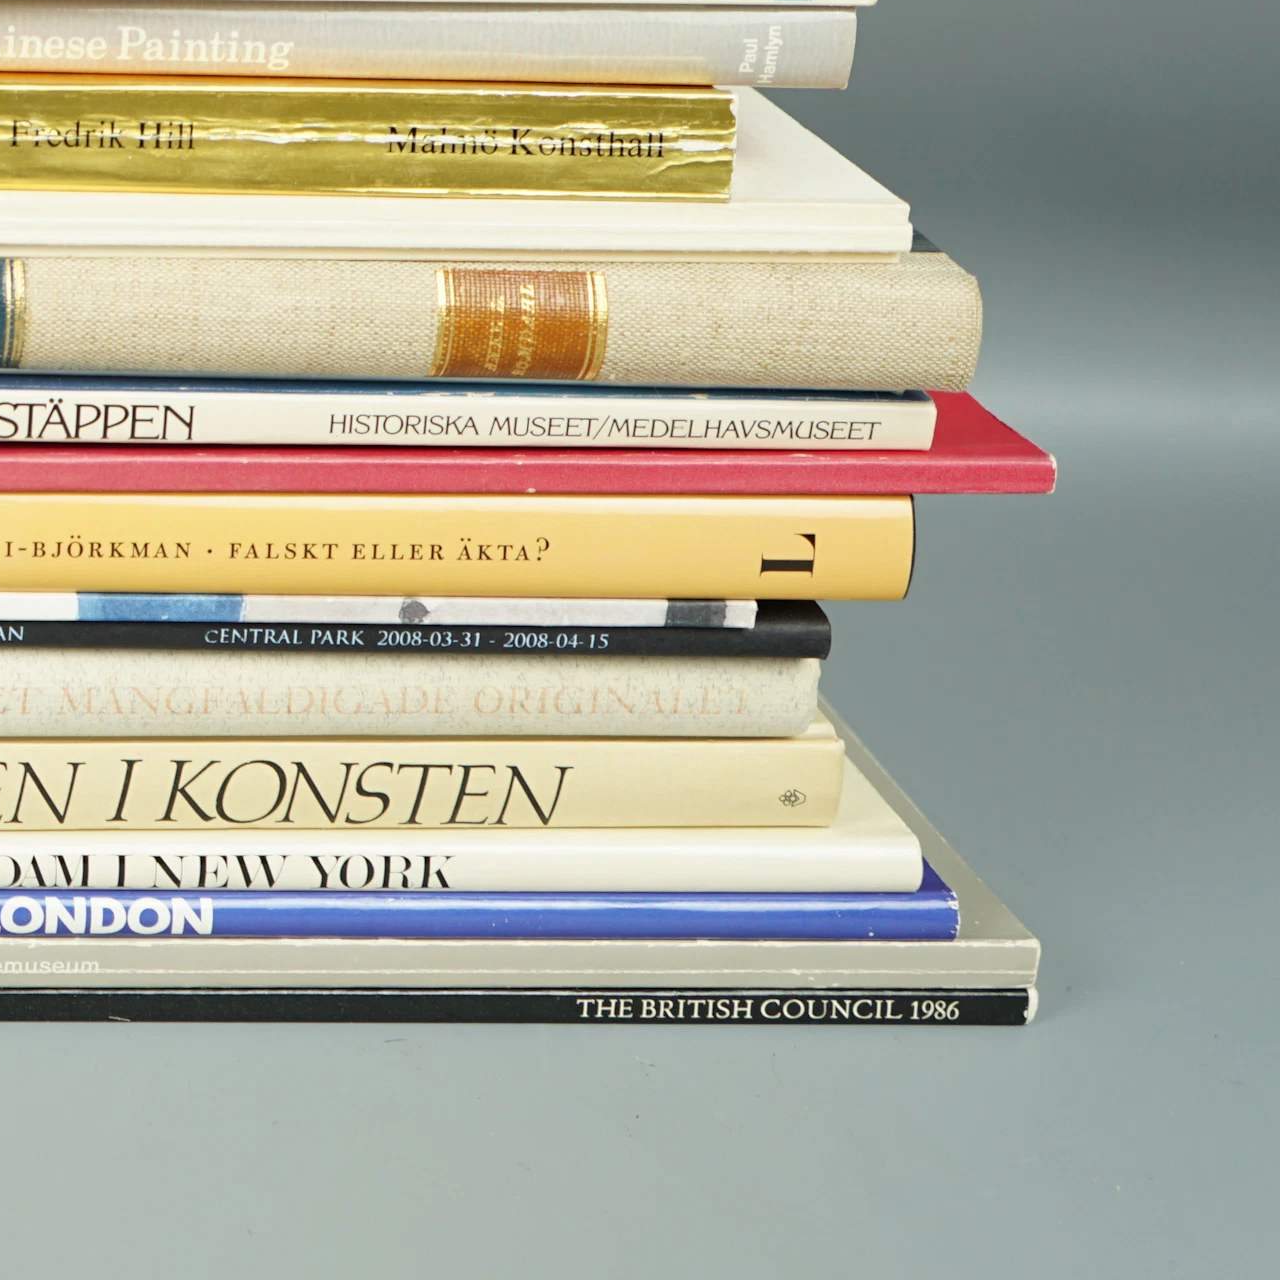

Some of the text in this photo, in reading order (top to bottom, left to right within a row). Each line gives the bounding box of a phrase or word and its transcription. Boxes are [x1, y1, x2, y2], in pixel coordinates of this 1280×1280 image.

[117, 27, 294, 68] Painting
[739, 38, 758, 74] Paul
[758, 25, 781, 85] Hamlyn
[10, 119, 126, 150] Fredrik
[138, 121, 196, 151] Hill
[387, 125, 666, 159] Malmö Konsthall
[329, 413, 882, 442] HISTORISKA MUSEET/MEDELHAVSMUSEET
[228, 537, 551, 563] FALSKT ELLER ÄKTA?
[760, 533, 816, 578] L
[204, 627, 609, 650] CENTRAL PARK 2008-03-31 2008-04-15
[57, 677, 454, 717] MÅNGFALDIGADE
[473, 684, 761, 717] ORIGINALET
[107, 759, 144, 823] I
[161, 759, 575, 827] KONSTEN
[115, 855, 137, 888] I
[150, 854, 288, 889] NEW
[309, 855, 457, 890] YORK
[576, 998, 960, 1021] THE BRITISH COUNCIL 1986
